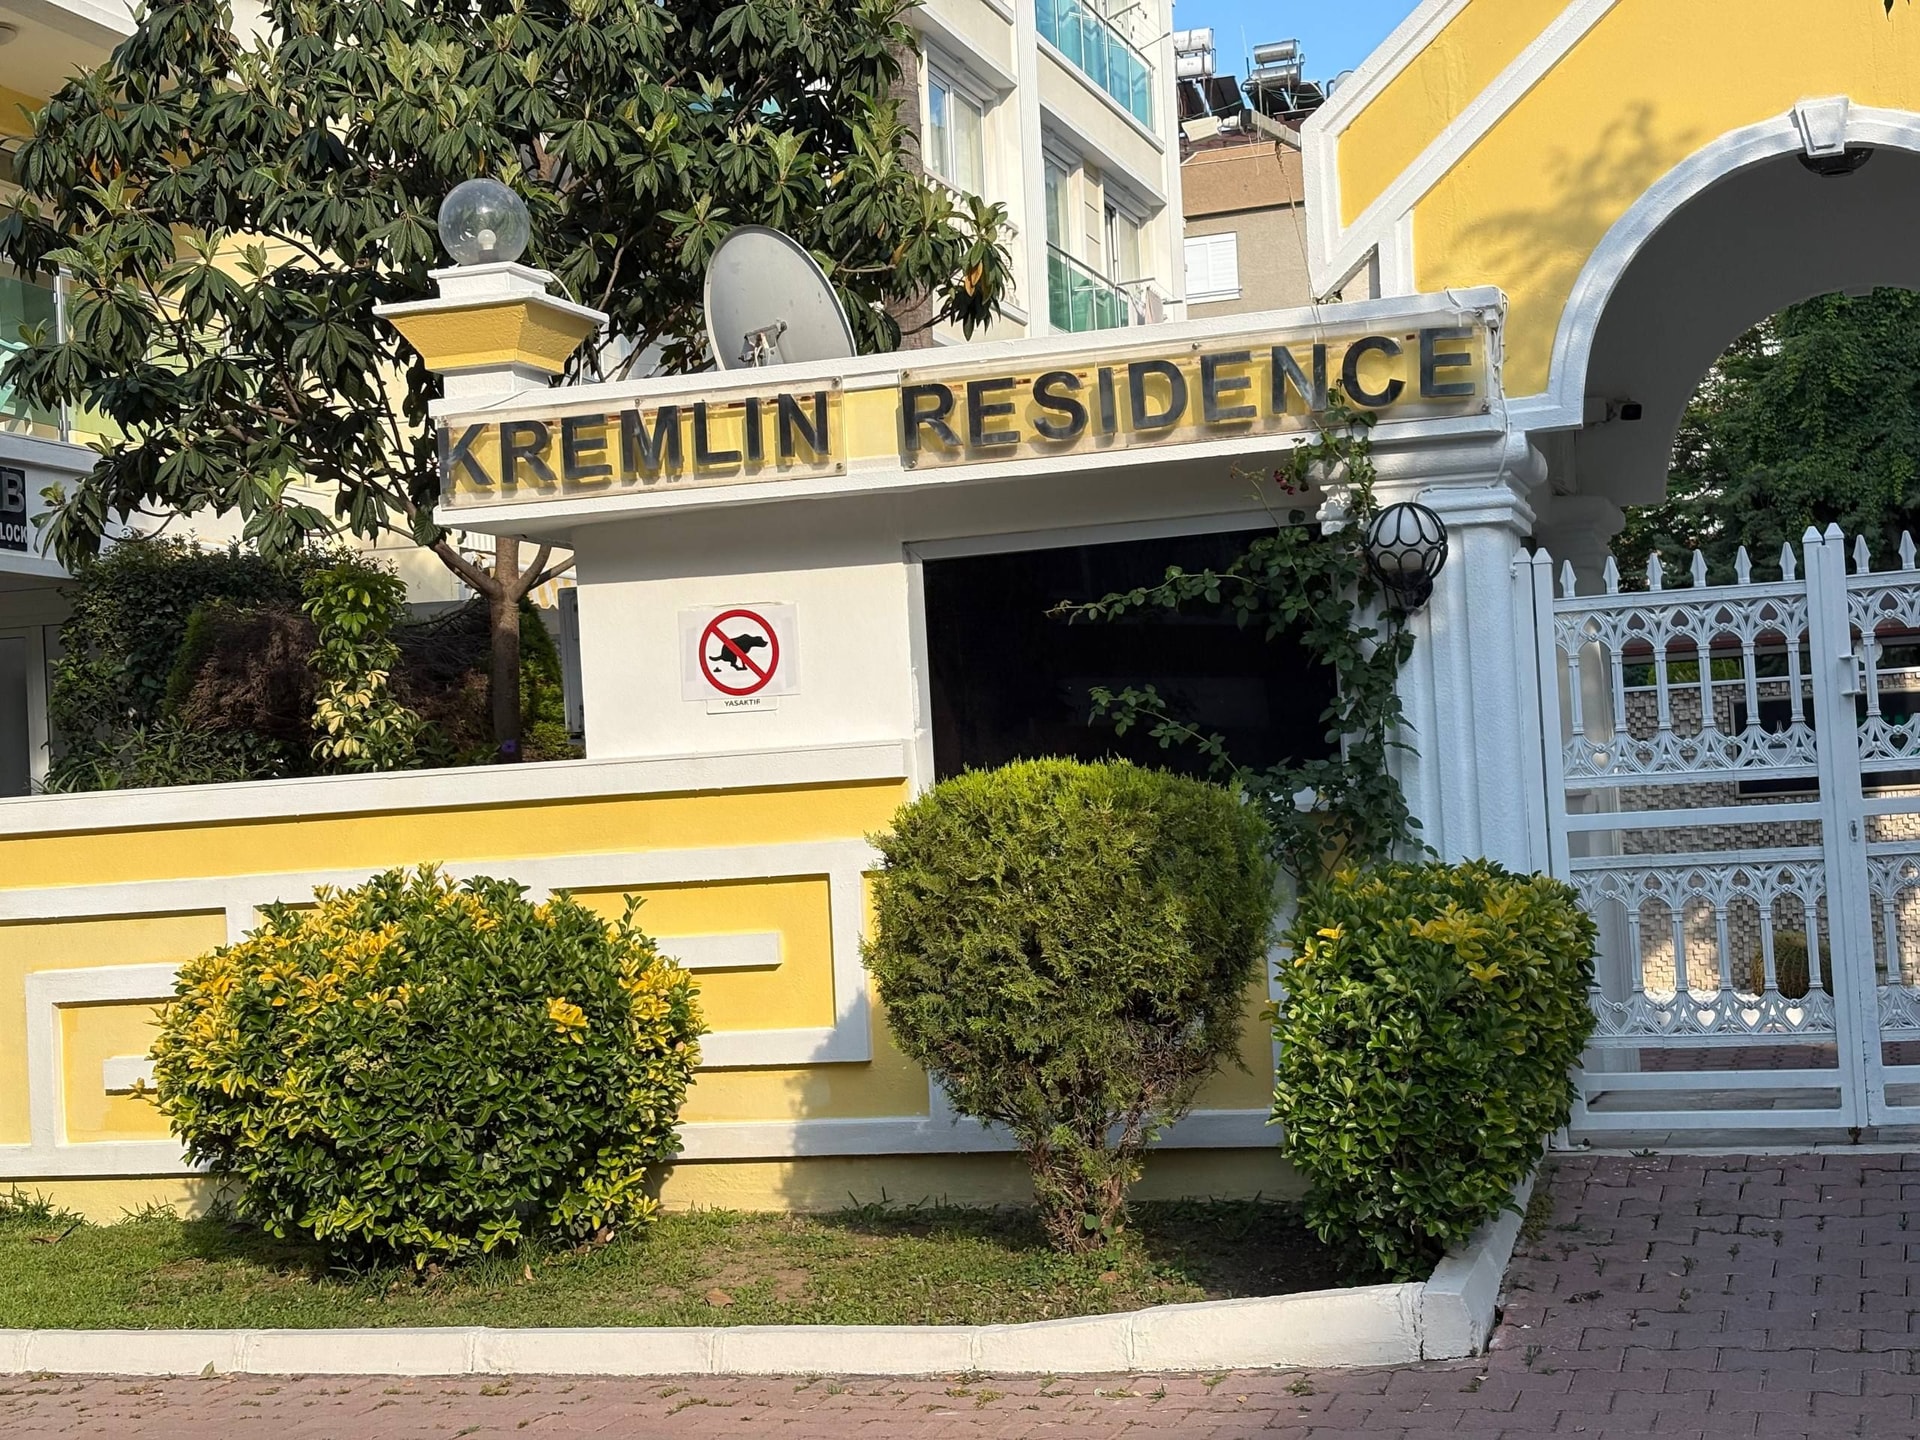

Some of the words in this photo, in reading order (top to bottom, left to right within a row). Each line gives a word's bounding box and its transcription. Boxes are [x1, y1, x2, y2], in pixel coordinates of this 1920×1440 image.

[437, 391, 830, 491] KREMLIN
[901, 327, 1475, 451] RESIDENCE
[0, 471, 25, 513] B
